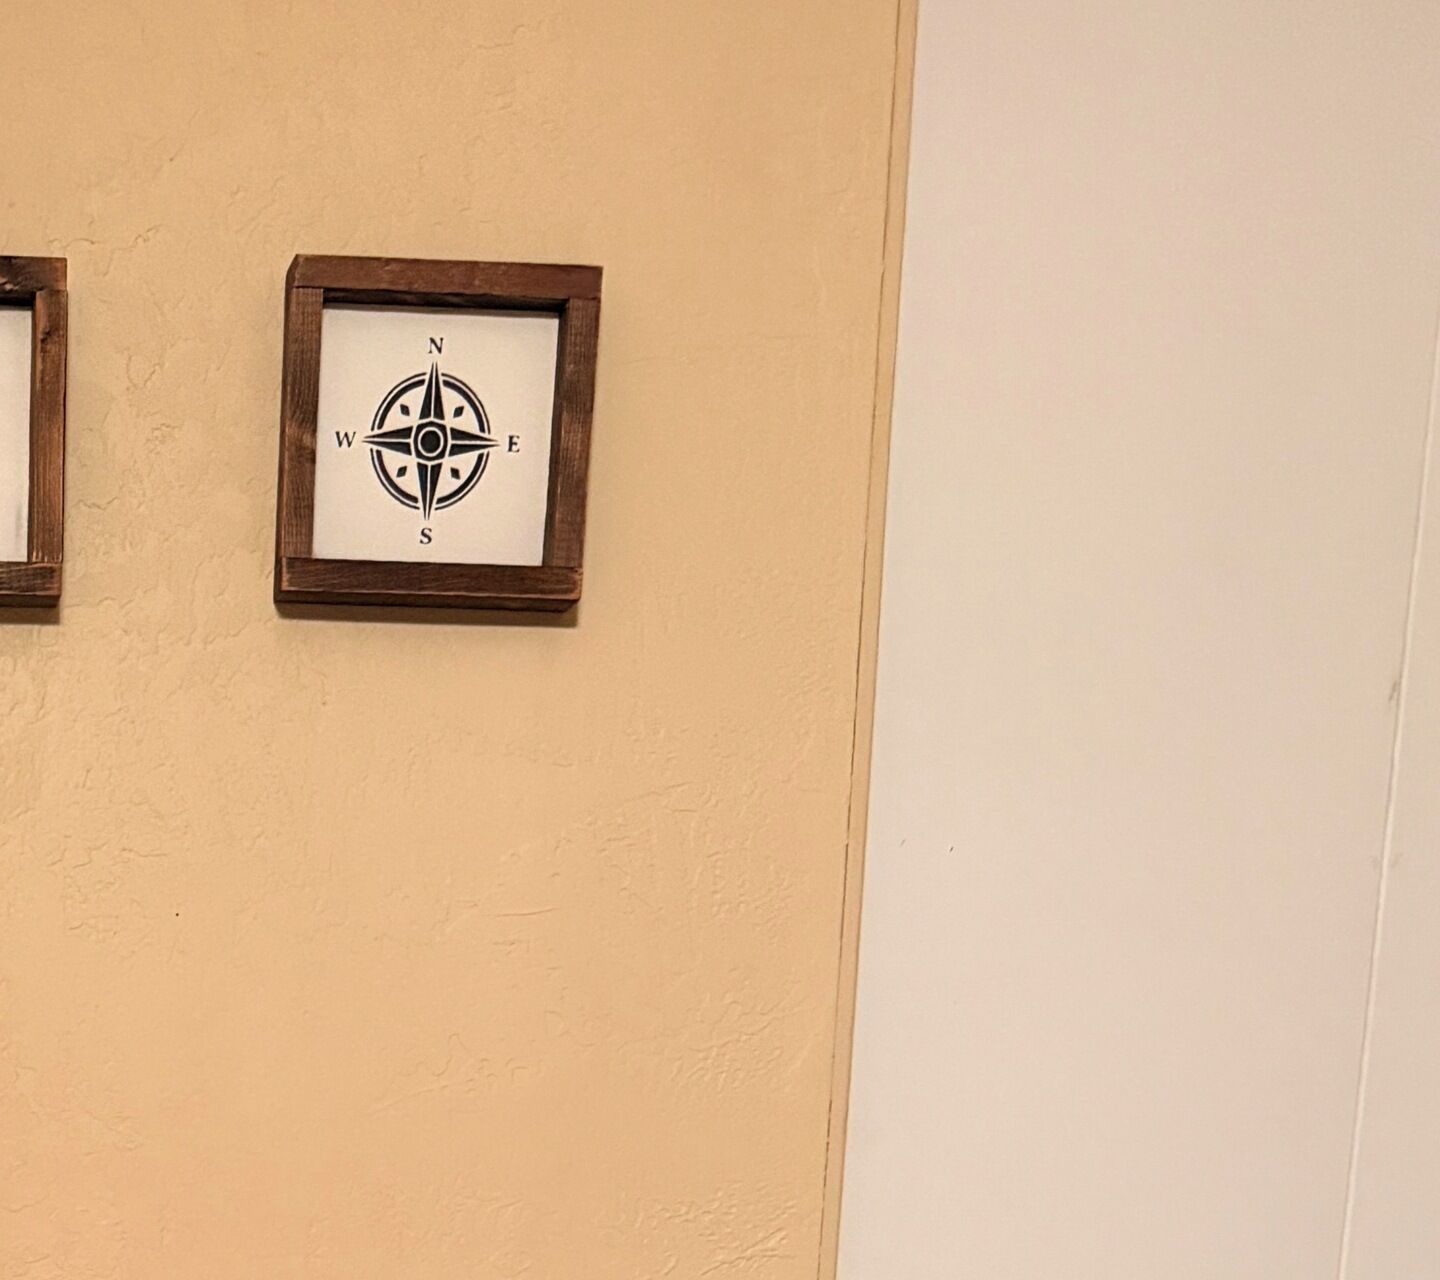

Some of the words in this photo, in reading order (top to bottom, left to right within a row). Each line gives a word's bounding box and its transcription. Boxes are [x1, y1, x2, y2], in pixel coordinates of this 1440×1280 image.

[428, 337, 444, 354] N
[335, 431, 356, 448] W
[507, 435, 520, 453] E
[419, 528, 433, 544] S
